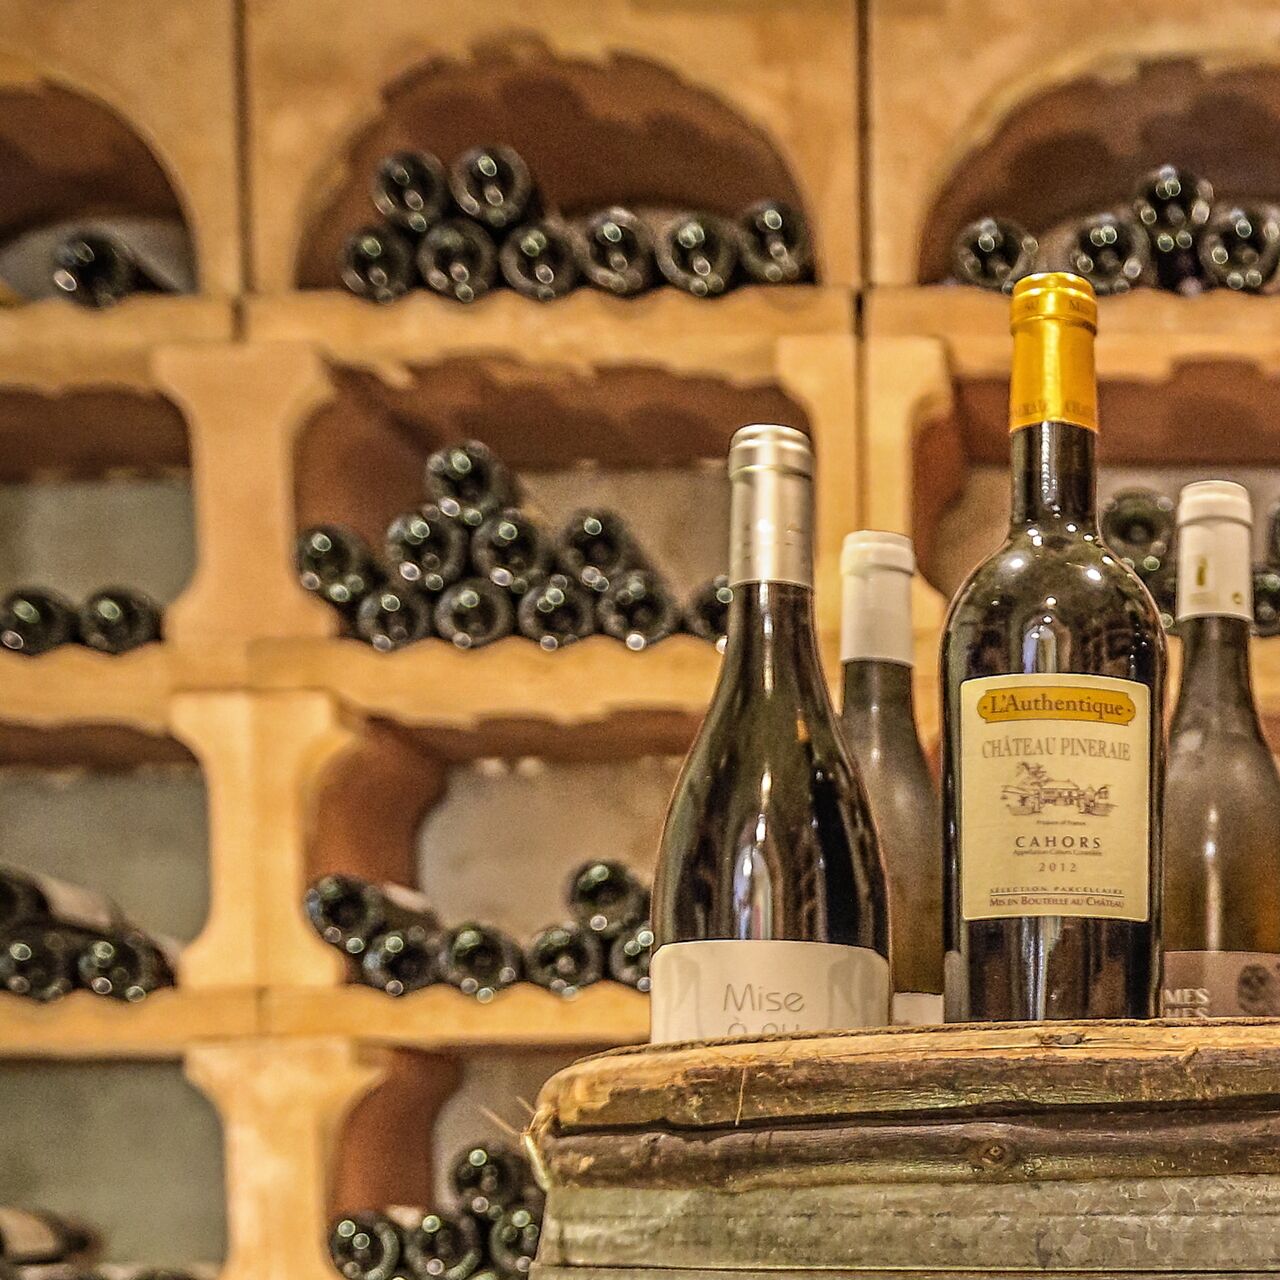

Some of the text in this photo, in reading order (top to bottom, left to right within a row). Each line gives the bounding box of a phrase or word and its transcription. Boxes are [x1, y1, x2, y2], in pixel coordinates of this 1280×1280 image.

[989, 692, 1124, 719] L'Authentique
[982, 735, 1132, 761] CHÂTEAU PINERAIE
[1015, 836, 1101, 849] CAHORS
[1038, 862, 1077, 873] 2012
[723, 983, 805, 1013] Mise
